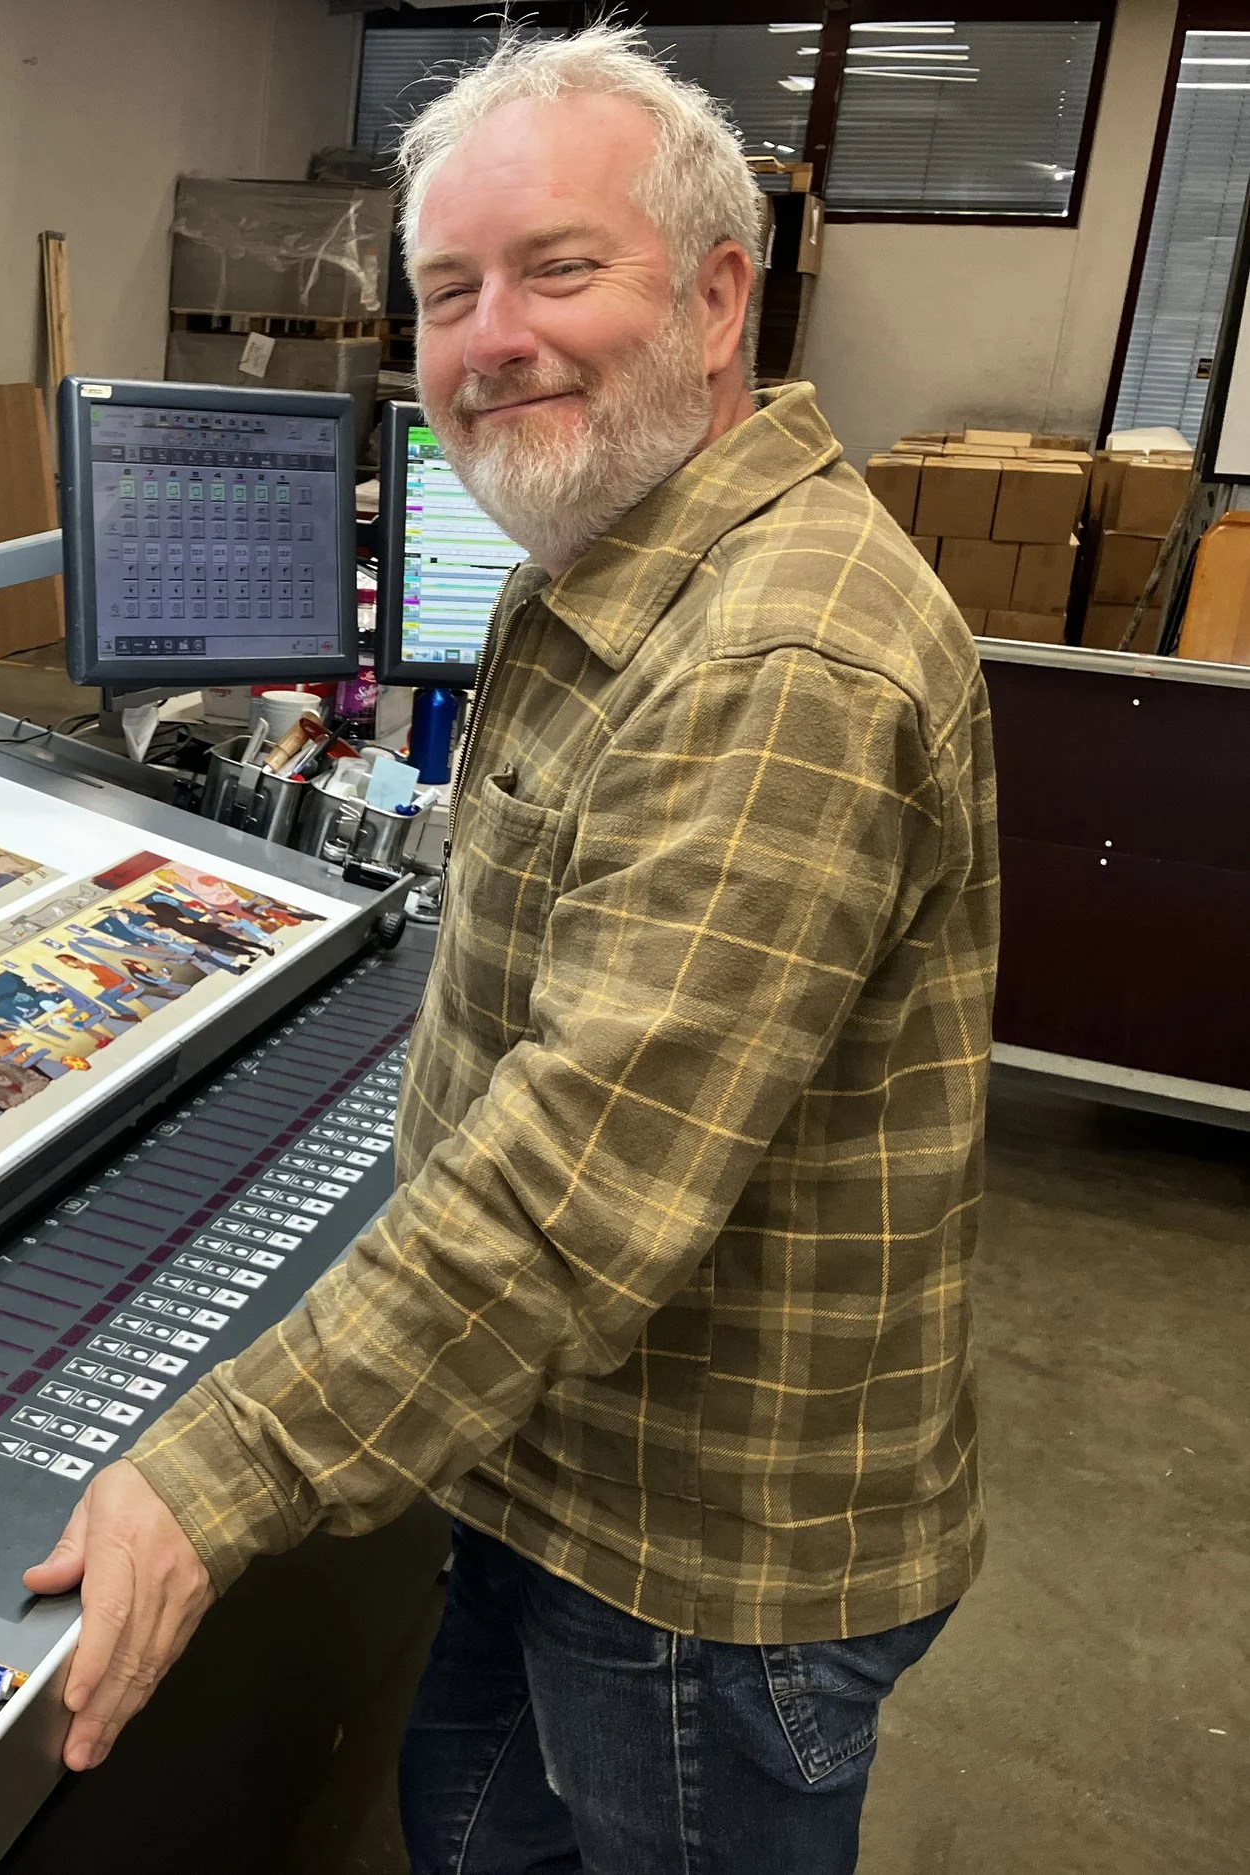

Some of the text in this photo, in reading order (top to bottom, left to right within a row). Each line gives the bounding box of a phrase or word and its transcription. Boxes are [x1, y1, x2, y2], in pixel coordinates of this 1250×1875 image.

[142, 1138, 156, 1147] 14
[123, 1153, 139, 1162] 13
[104, 1168, 121, 1177] 12
[85, 1184, 100, 1193] 11
[64, 1200, 81, 1210] 10
[22, 1236, 37, 1244] 8
